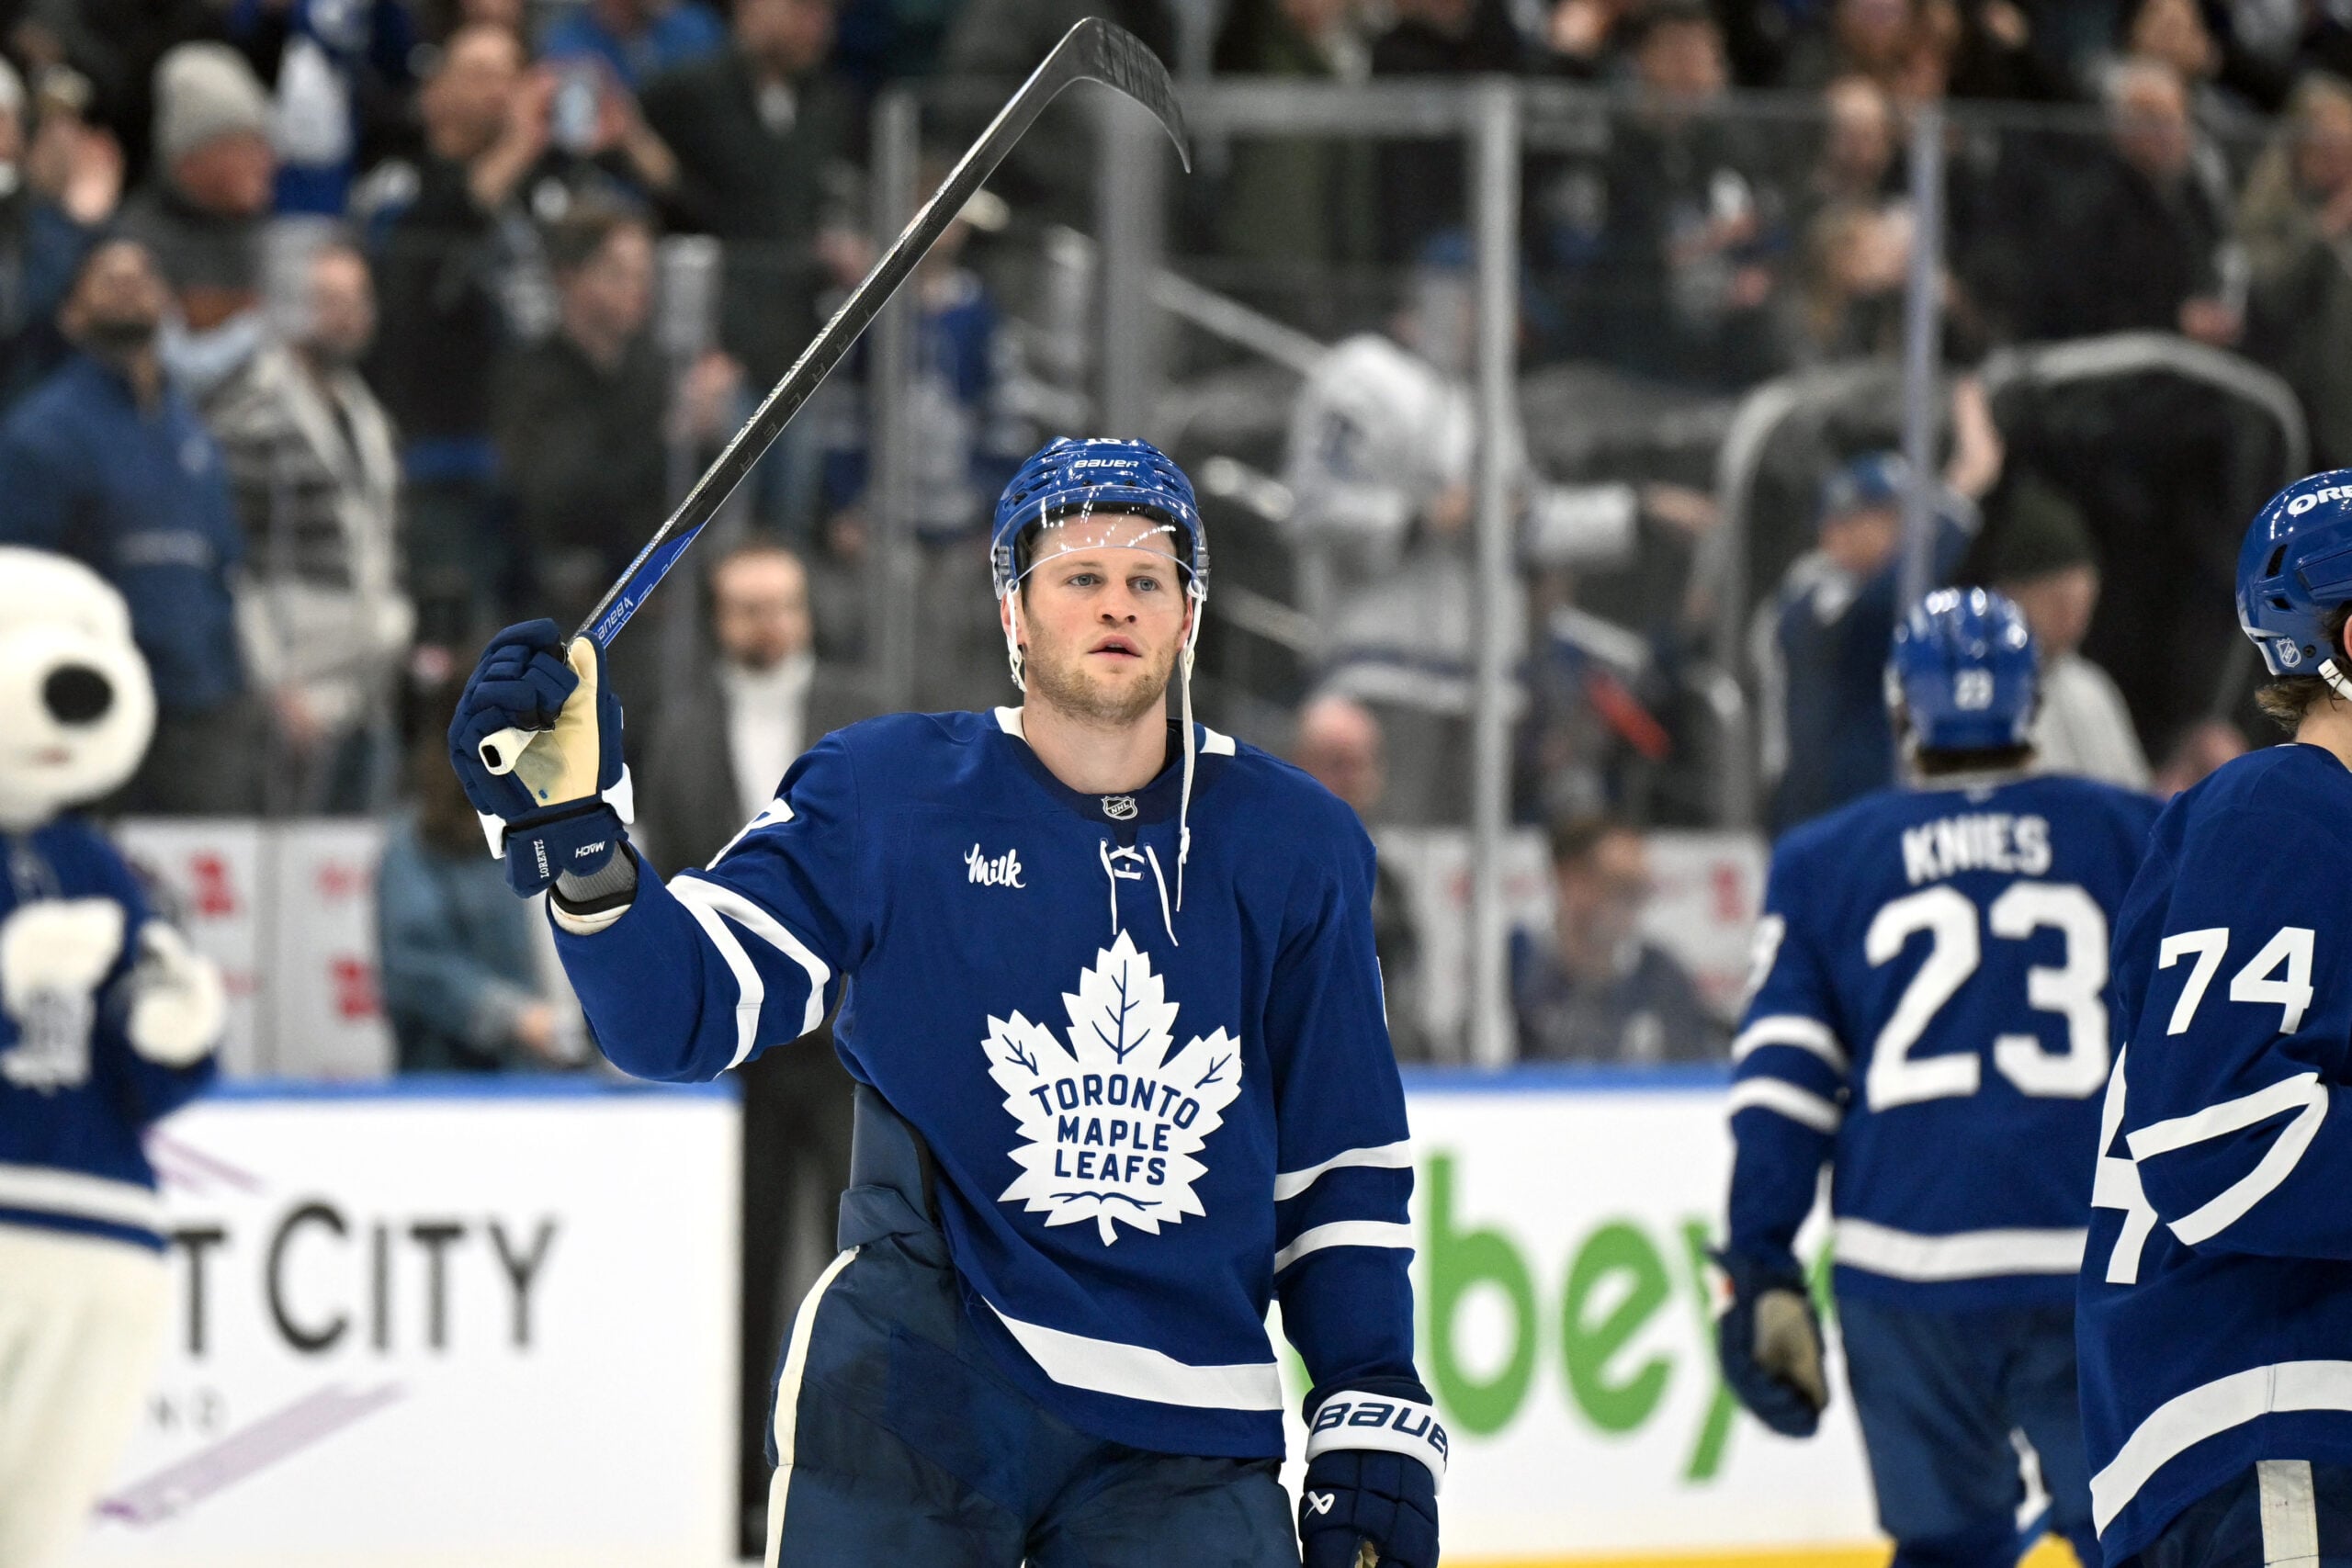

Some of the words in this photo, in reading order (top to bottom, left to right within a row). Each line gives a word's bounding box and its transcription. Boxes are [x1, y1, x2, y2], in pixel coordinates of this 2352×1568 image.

[1074, 459, 1139, 468] BAUER
[597, 604, 626, 640] BAUE
[533, 839, 549, 879] LORENTZ
[575, 840, 605, 858] MACH
[965, 843, 1026, 888] Milk
[1902, 814, 2052, 886] KNIES
[1865, 883, 2110, 1113] 23
[2158, 926, 2315, 1035] 74
[1029, 1073, 1200, 1130] TORONTO
[1057, 1114, 1171, 1152] MAPLE
[1054, 1148, 1167, 1186] LEAFS
[263, 1193, 560, 1359] CITY
